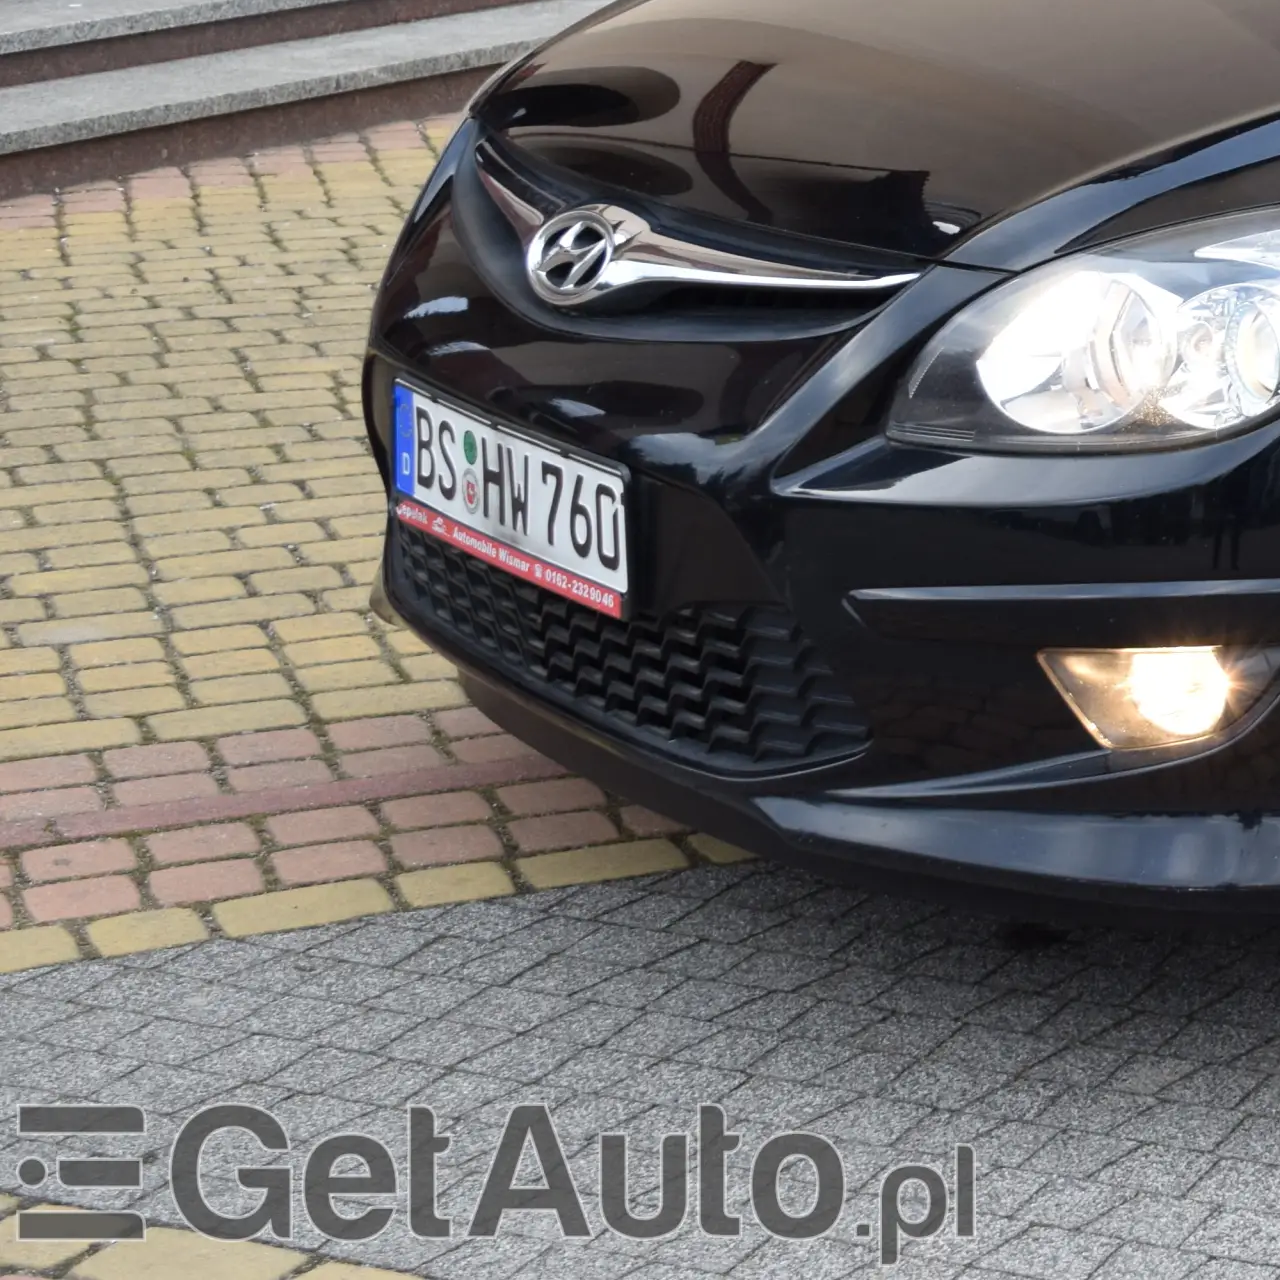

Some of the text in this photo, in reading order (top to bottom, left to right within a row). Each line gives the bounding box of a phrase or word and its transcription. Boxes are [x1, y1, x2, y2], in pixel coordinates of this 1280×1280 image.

[402, 452, 410, 475] D
[416, 406, 621, 571] BS HW 760
[453, 526, 497, 558] Automobile
[498, 546, 530, 572] Wismar
